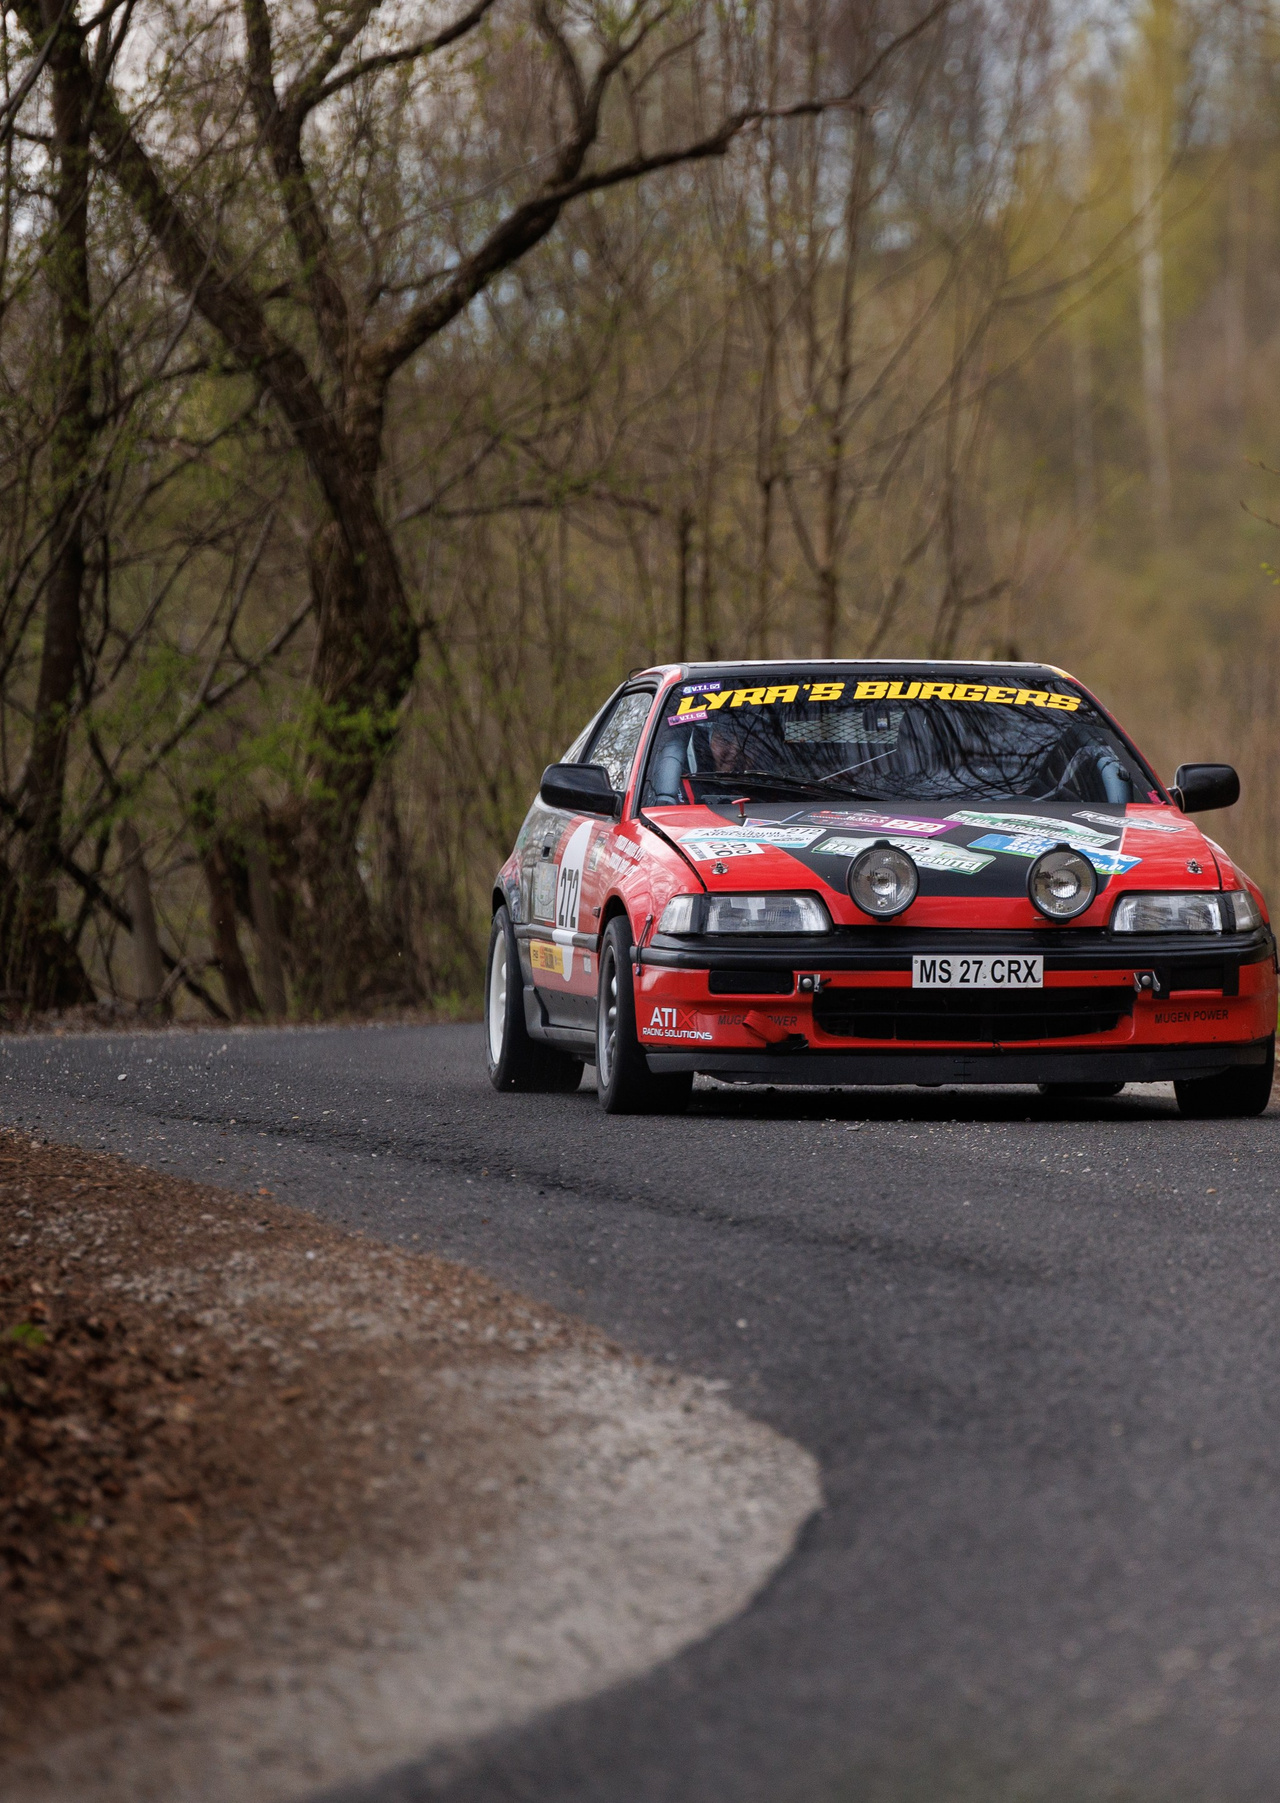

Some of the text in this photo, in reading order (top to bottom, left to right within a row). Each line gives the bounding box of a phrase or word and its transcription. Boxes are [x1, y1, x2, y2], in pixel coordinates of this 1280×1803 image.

[676, 681, 1082, 715] LYRA'S BURGERS
[890, 820, 939, 832] 272
[558, 867, 579, 928] 272
[919, 959, 1038, 983] MS 27 CRX
[650, 1006, 698, 1029] ATIX
[1154, 1009, 1229, 1024] MUGEN POWER
[642, 1027, 713, 1041] RACING SOLUTIONS
